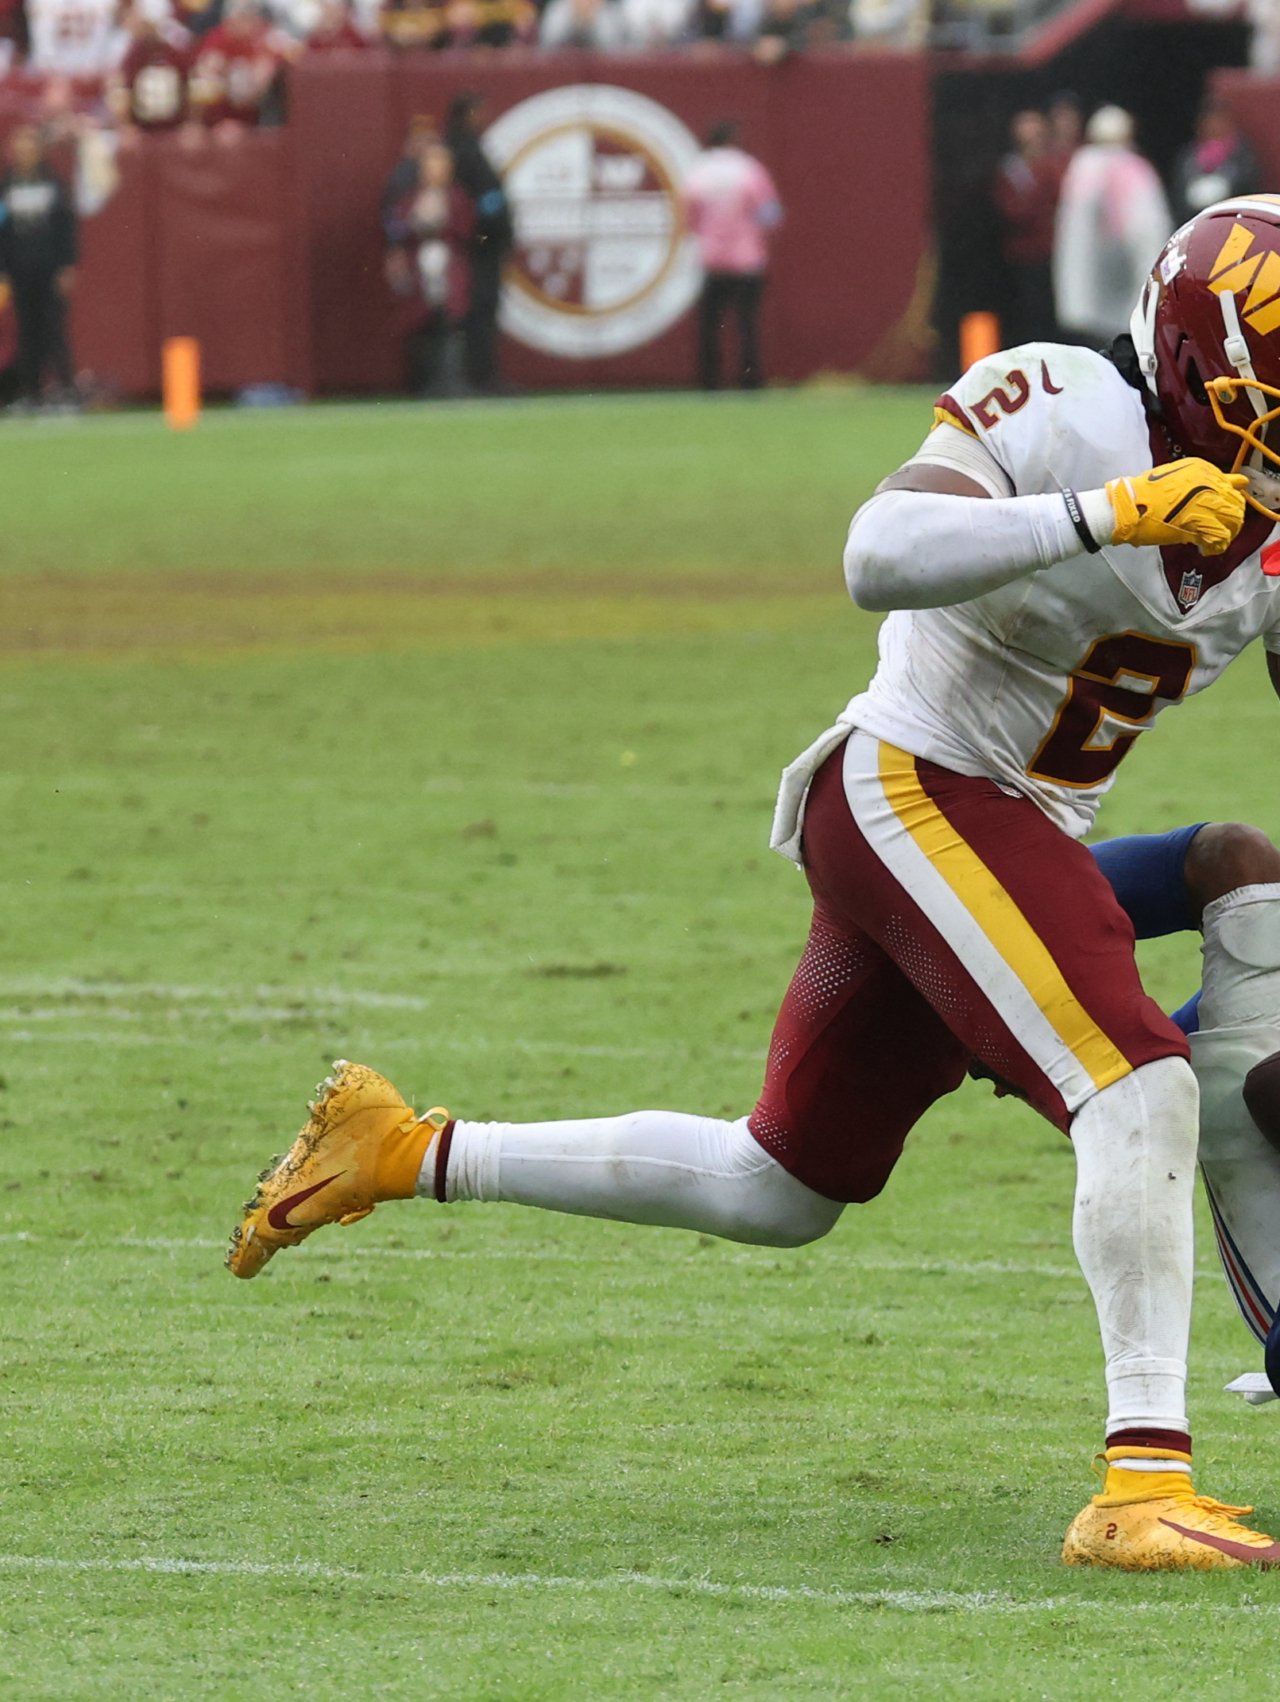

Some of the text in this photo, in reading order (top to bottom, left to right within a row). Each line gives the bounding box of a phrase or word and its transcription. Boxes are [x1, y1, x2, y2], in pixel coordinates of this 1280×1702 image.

[969, 368, 1031, 432] 2
[1025, 629, 1197, 789] 2
[1105, 1522, 1118, 1540] 2
